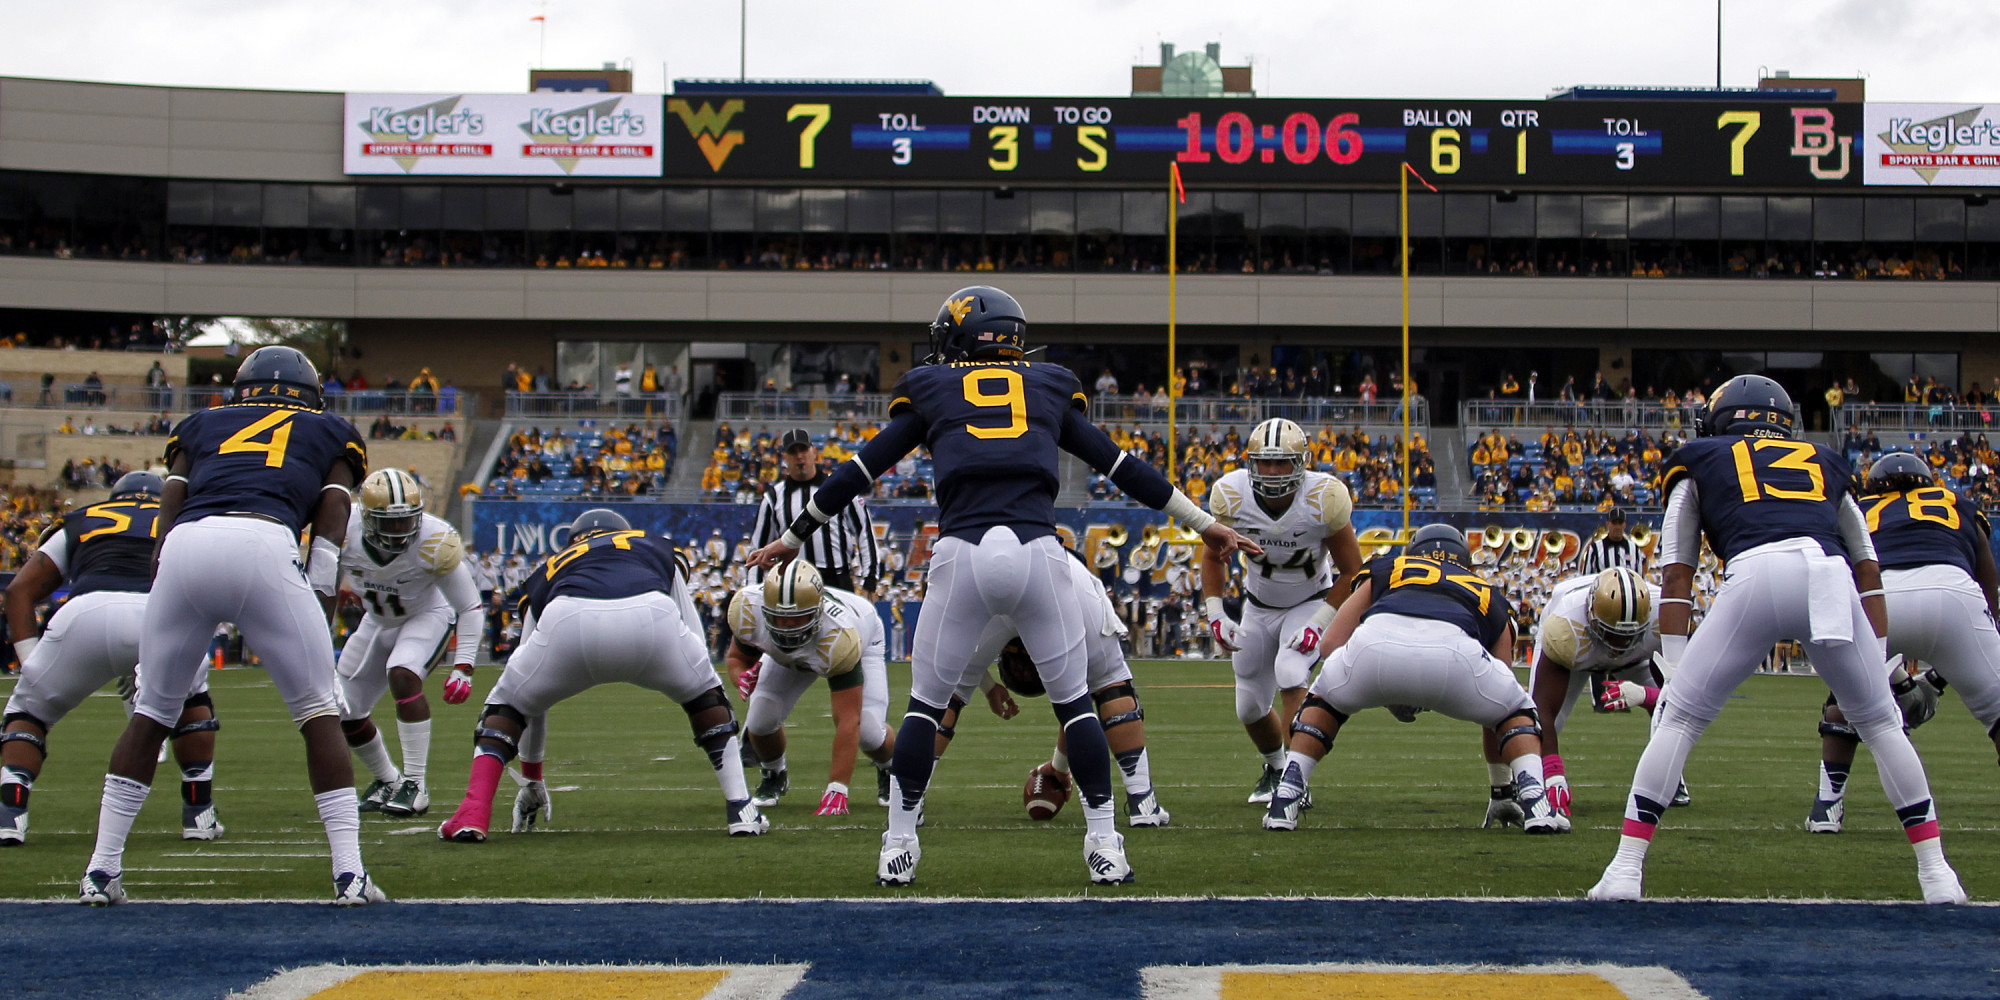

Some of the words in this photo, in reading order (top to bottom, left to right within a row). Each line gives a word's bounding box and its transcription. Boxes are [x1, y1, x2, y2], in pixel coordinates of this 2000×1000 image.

[370, 107, 484, 141] Kegler's
[530, 108, 645, 142] Kegler's
[879, 113, 925, 131] T.O.L.
[973, 106, 1030, 123] DOWN
[1054, 107, 1080, 124] TO
[1083, 107, 1112, 124] GO
[1403, 109, 1445, 127] BALL
[1446, 109, 1472, 127] ON
[1500, 110, 1539, 129] QTR
[1604, 119, 1647, 137] T.O.L.
[369, 145, 412, 154] SPORTS
[415, 145, 438, 154] BAR
[441, 145, 449, 154] &
[452, 145, 484, 154] GRILL
[787, 103, 831, 168] 7
[988, 125, 1018, 171] 3
[1077, 125, 1107, 171] 5
[1176, 112, 1364, 164] 10:06
[1717, 110, 1761, 177] 7
[530, 146, 573, 156] SPORTS
[575, 146, 598, 156] BAR
[601, 146, 609, 156] &
[613, 146, 645, 156] GRILL
[892, 137, 912, 165] 3
[1431, 129, 1461, 175] 6
[1517, 130, 1527, 175] 1
[1615, 143, 1635, 171] 3
[1889, 156, 1933, 165] SPORTS
[1936, 156, 1958, 165] BAR
[1962, 156, 1970, 165] &
[962, 368, 1029, 439] 9
[1766, 411, 1778, 424] 13
[218, 408, 299, 469] 4
[1730, 438, 1827, 503] 13
[1858, 486, 1961, 534] 78
[1259, 539, 1298, 548] BAYLOR
[1245, 547, 1317, 580] 44
[364, 582, 399, 594] BAYLOR
[1389, 555, 1492, 617] 64
[363, 590, 407, 617] 11
[887, 850, 913, 875] NIKE
[1087, 851, 1116, 875] NIKE
